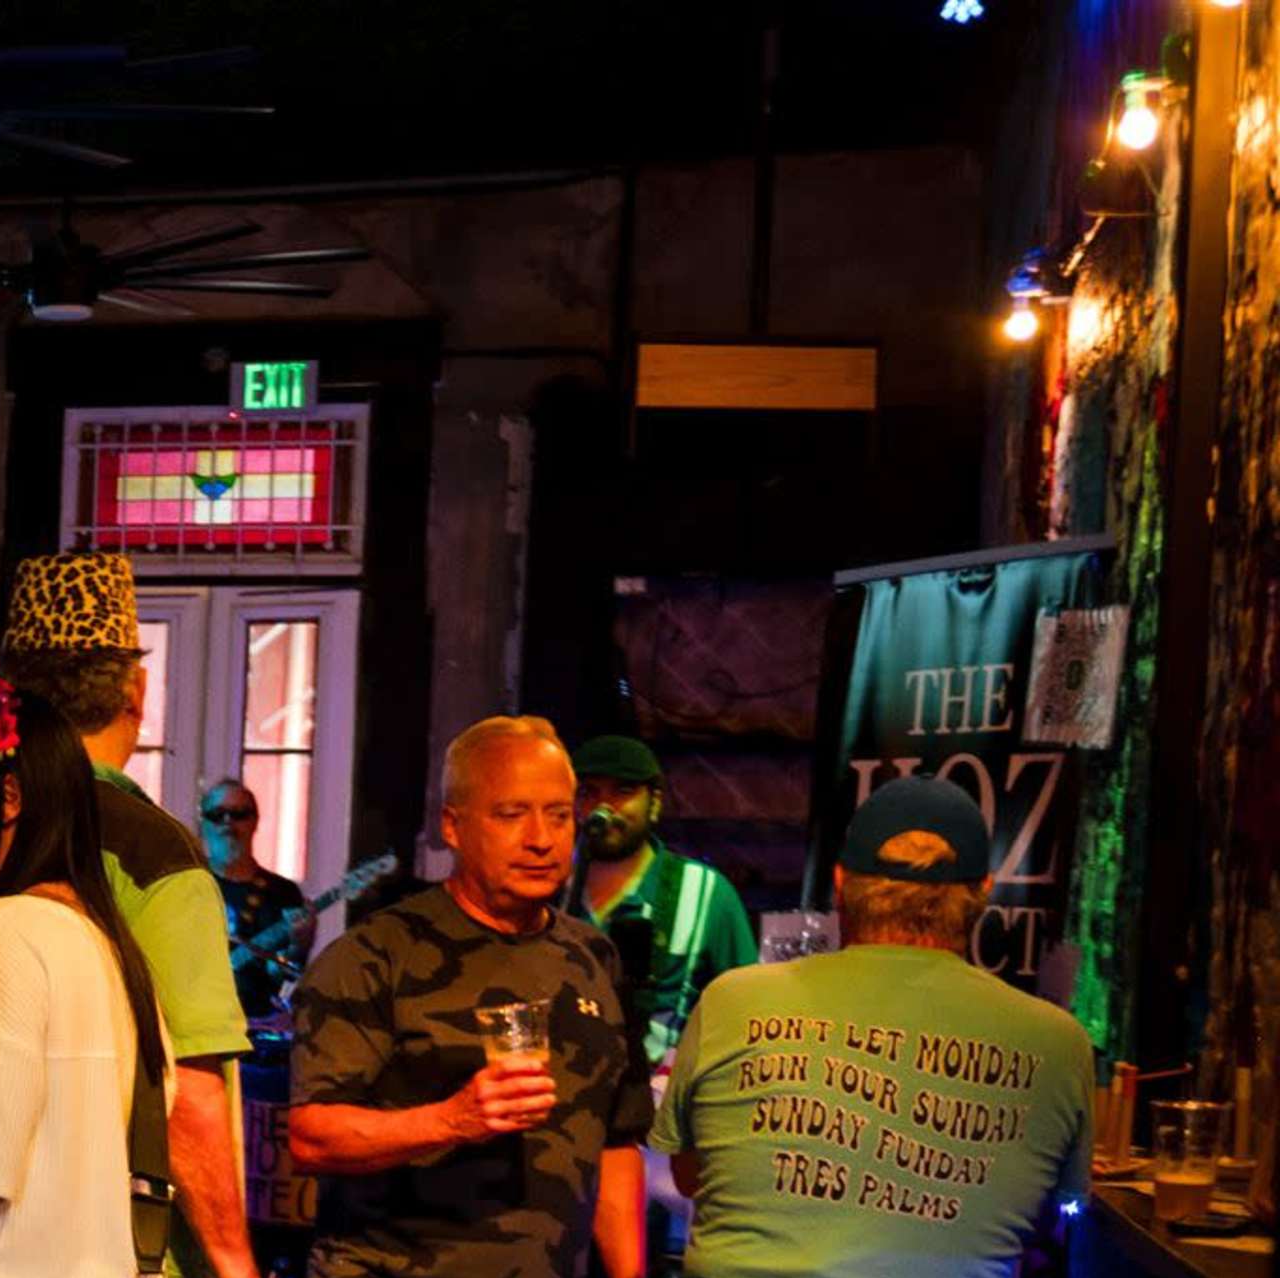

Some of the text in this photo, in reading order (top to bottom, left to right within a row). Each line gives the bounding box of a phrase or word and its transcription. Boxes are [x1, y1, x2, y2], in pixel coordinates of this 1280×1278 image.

[244, 363, 307, 409] EXIT
[904, 662, 1015, 736] THE
[969, 905, 1047, 976] CT
[738, 1055, 808, 1091] RUIN
[824, 1057, 898, 1114] YOUR
[746, 1017, 1041, 1089] DON'T LET MONDAY
[752, 1096, 993, 1185] SUNDAY FUNDAY
[775, 1153, 960, 1220] TRES PALMS
